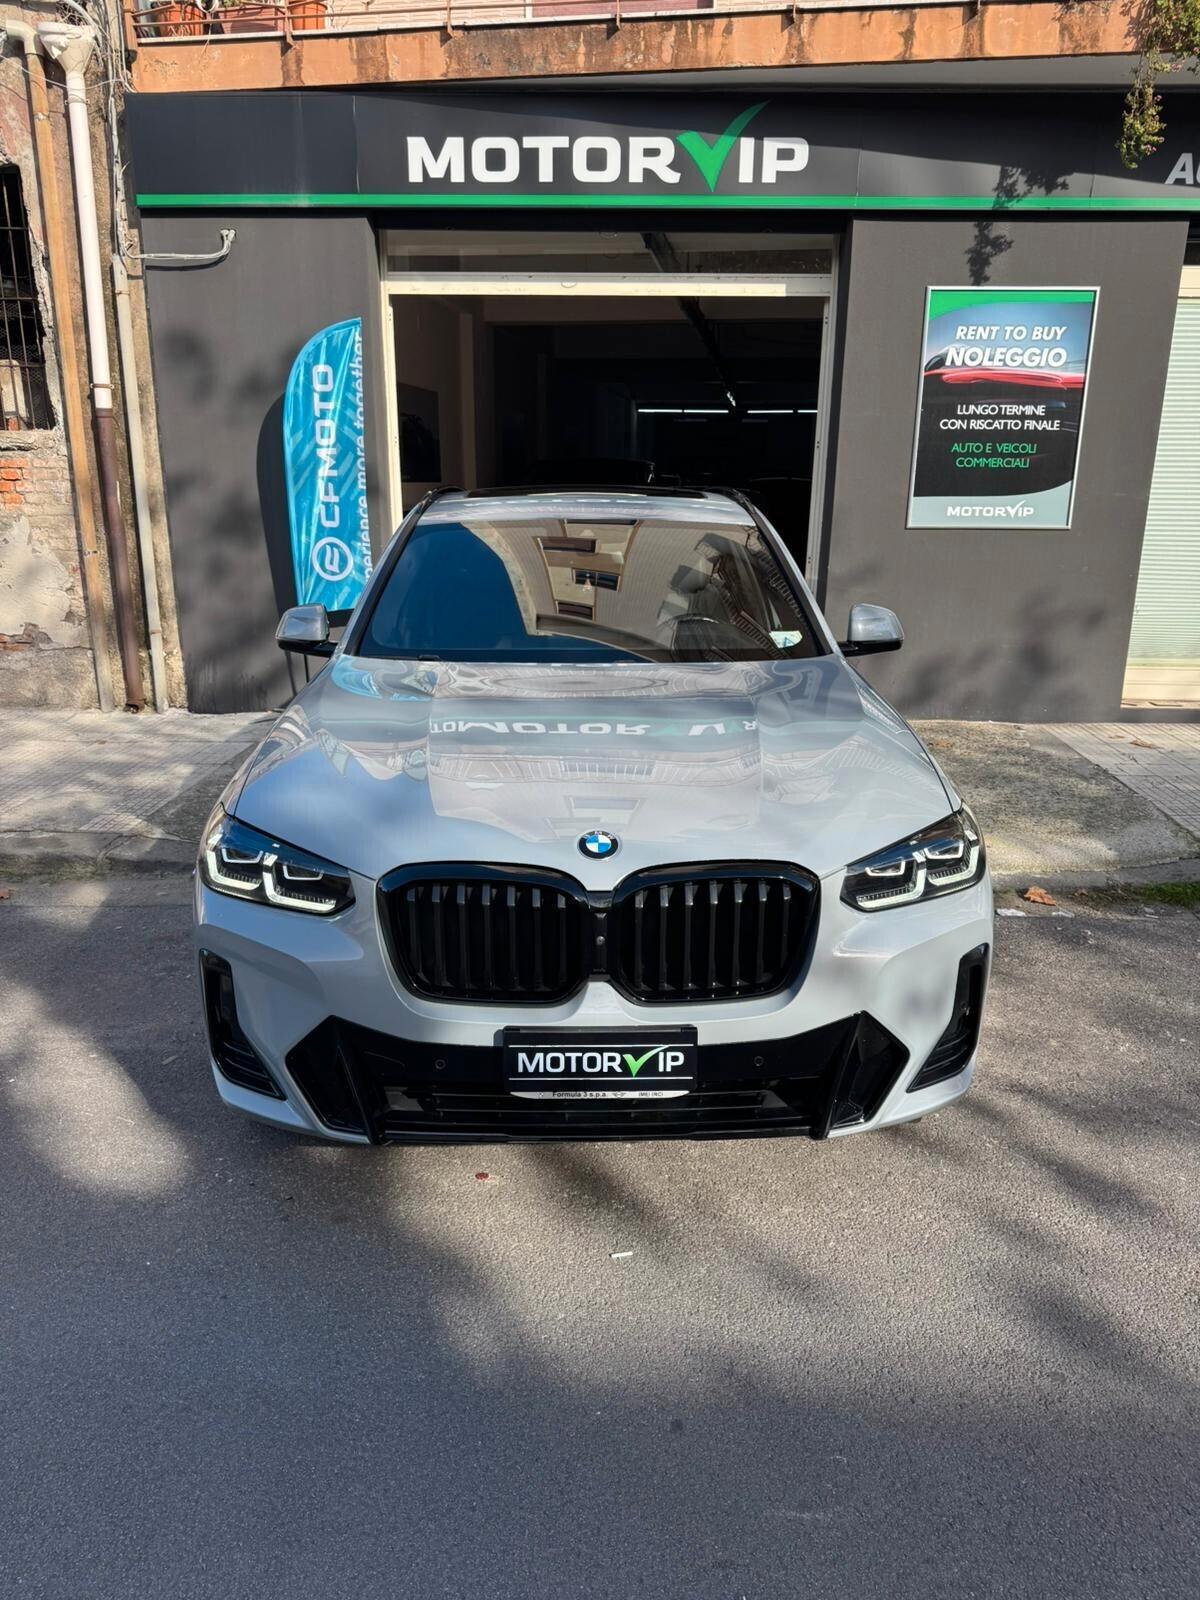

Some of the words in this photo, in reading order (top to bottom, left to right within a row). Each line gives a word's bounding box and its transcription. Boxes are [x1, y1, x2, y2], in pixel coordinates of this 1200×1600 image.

[406, 100, 809, 193] MOTORVIP
[1164, 152, 1200, 186] A
[955, 325, 1000, 341] RENT
[1004, 325, 1027, 341] TO
[1031, 325, 1067, 341] BUY
[945, 347, 1067, 367] NOLEGGIO
[957, 404, 999, 416] LUNGO
[1000, 404, 1046, 416] TERMINE
[940, 419, 967, 430] CON
[969, 419, 1022, 430] RISCATTO
[1024, 419, 1060, 431] FINALE
[311, 364, 340, 528] CFMOTO
[951, 443, 984, 453] AUTO
[985, 443, 992, 453] E
[996, 443, 1037, 454] VEICOLI
[955, 458, 1030, 468] COMMERCIALI
[947, 500, 1034, 519] MOTORVIP
[358, 496, 374, 584] perience
[517, 1045, 685, 1078] MOTORVIP
